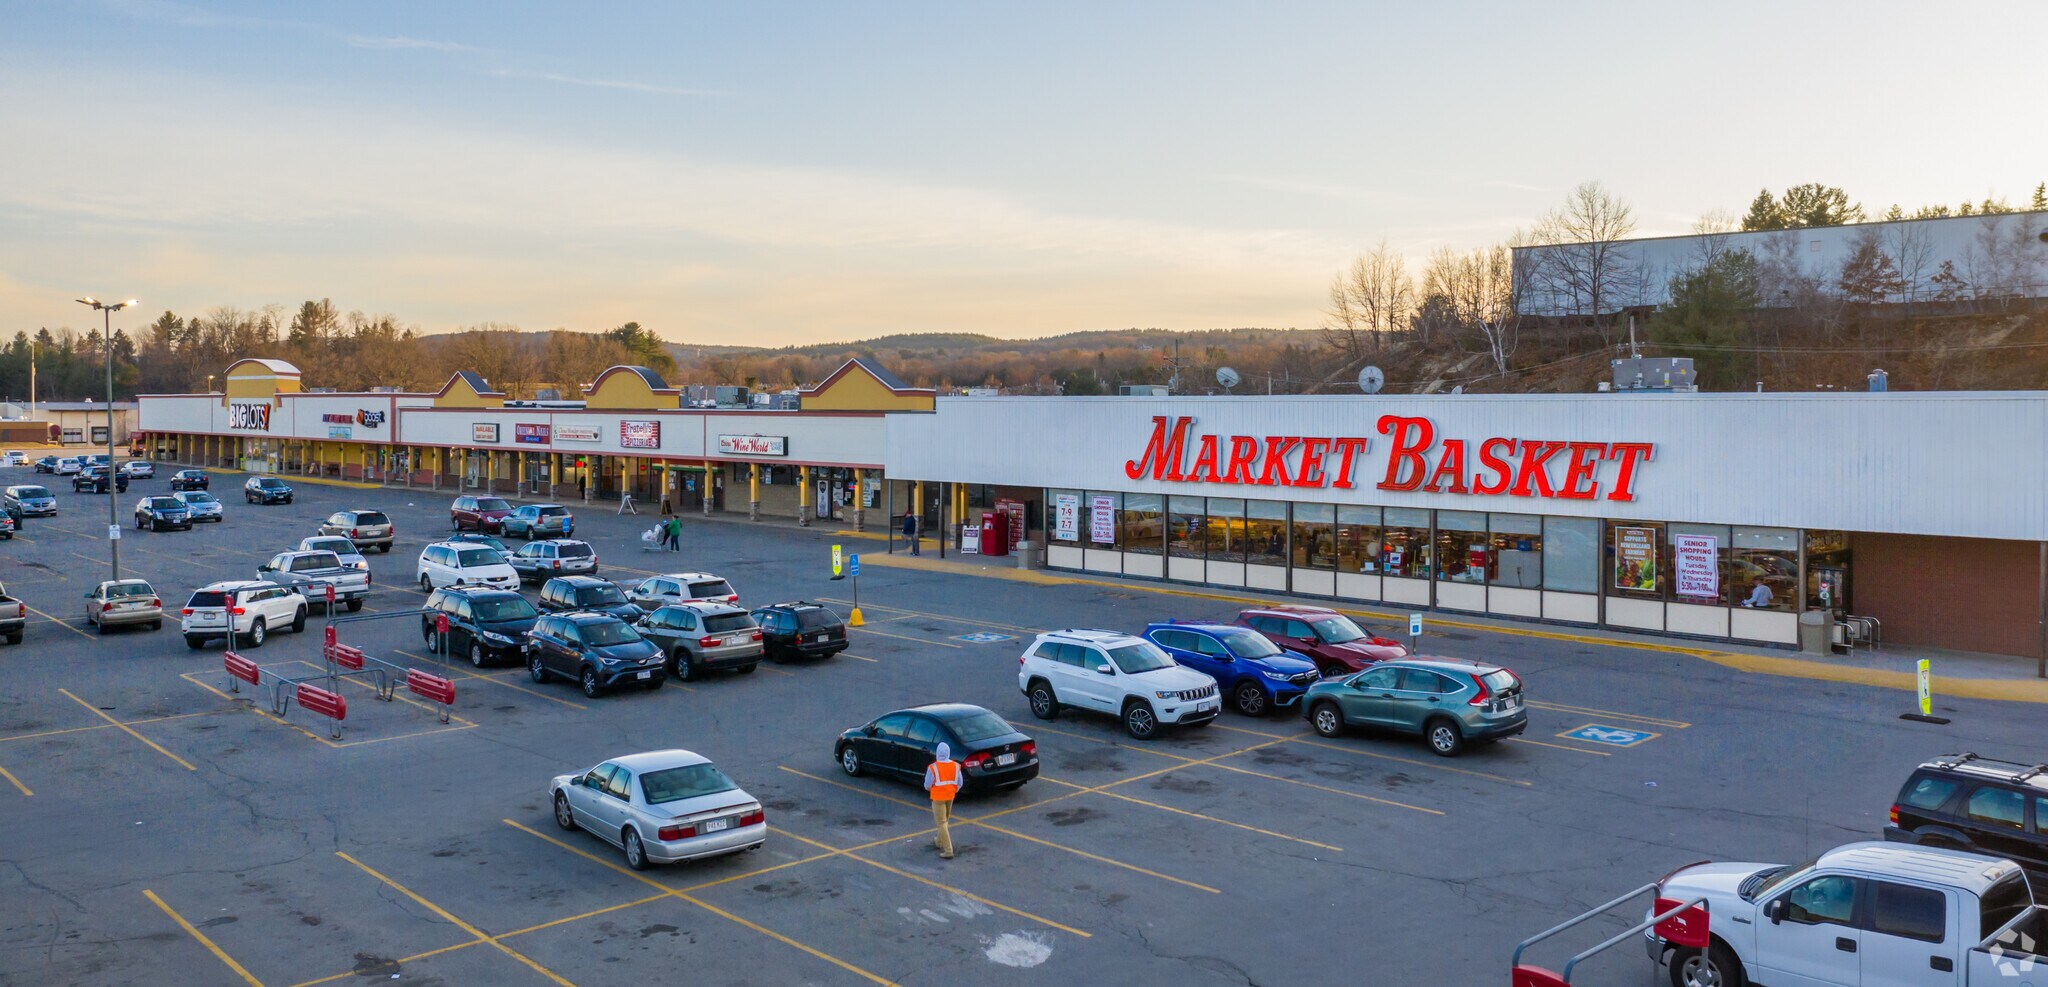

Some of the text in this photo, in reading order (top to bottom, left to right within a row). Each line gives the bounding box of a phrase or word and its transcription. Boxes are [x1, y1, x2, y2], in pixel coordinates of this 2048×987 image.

[230, 404, 247, 429] BIG
[732, 437, 749, 452] Wine
[749, 438, 769, 453] World
[1124, 414, 1655, 502] MARKET BASKET
[1680, 547, 1712, 555] SHOPPING
[1681, 569, 1713, 577] Wednesday
